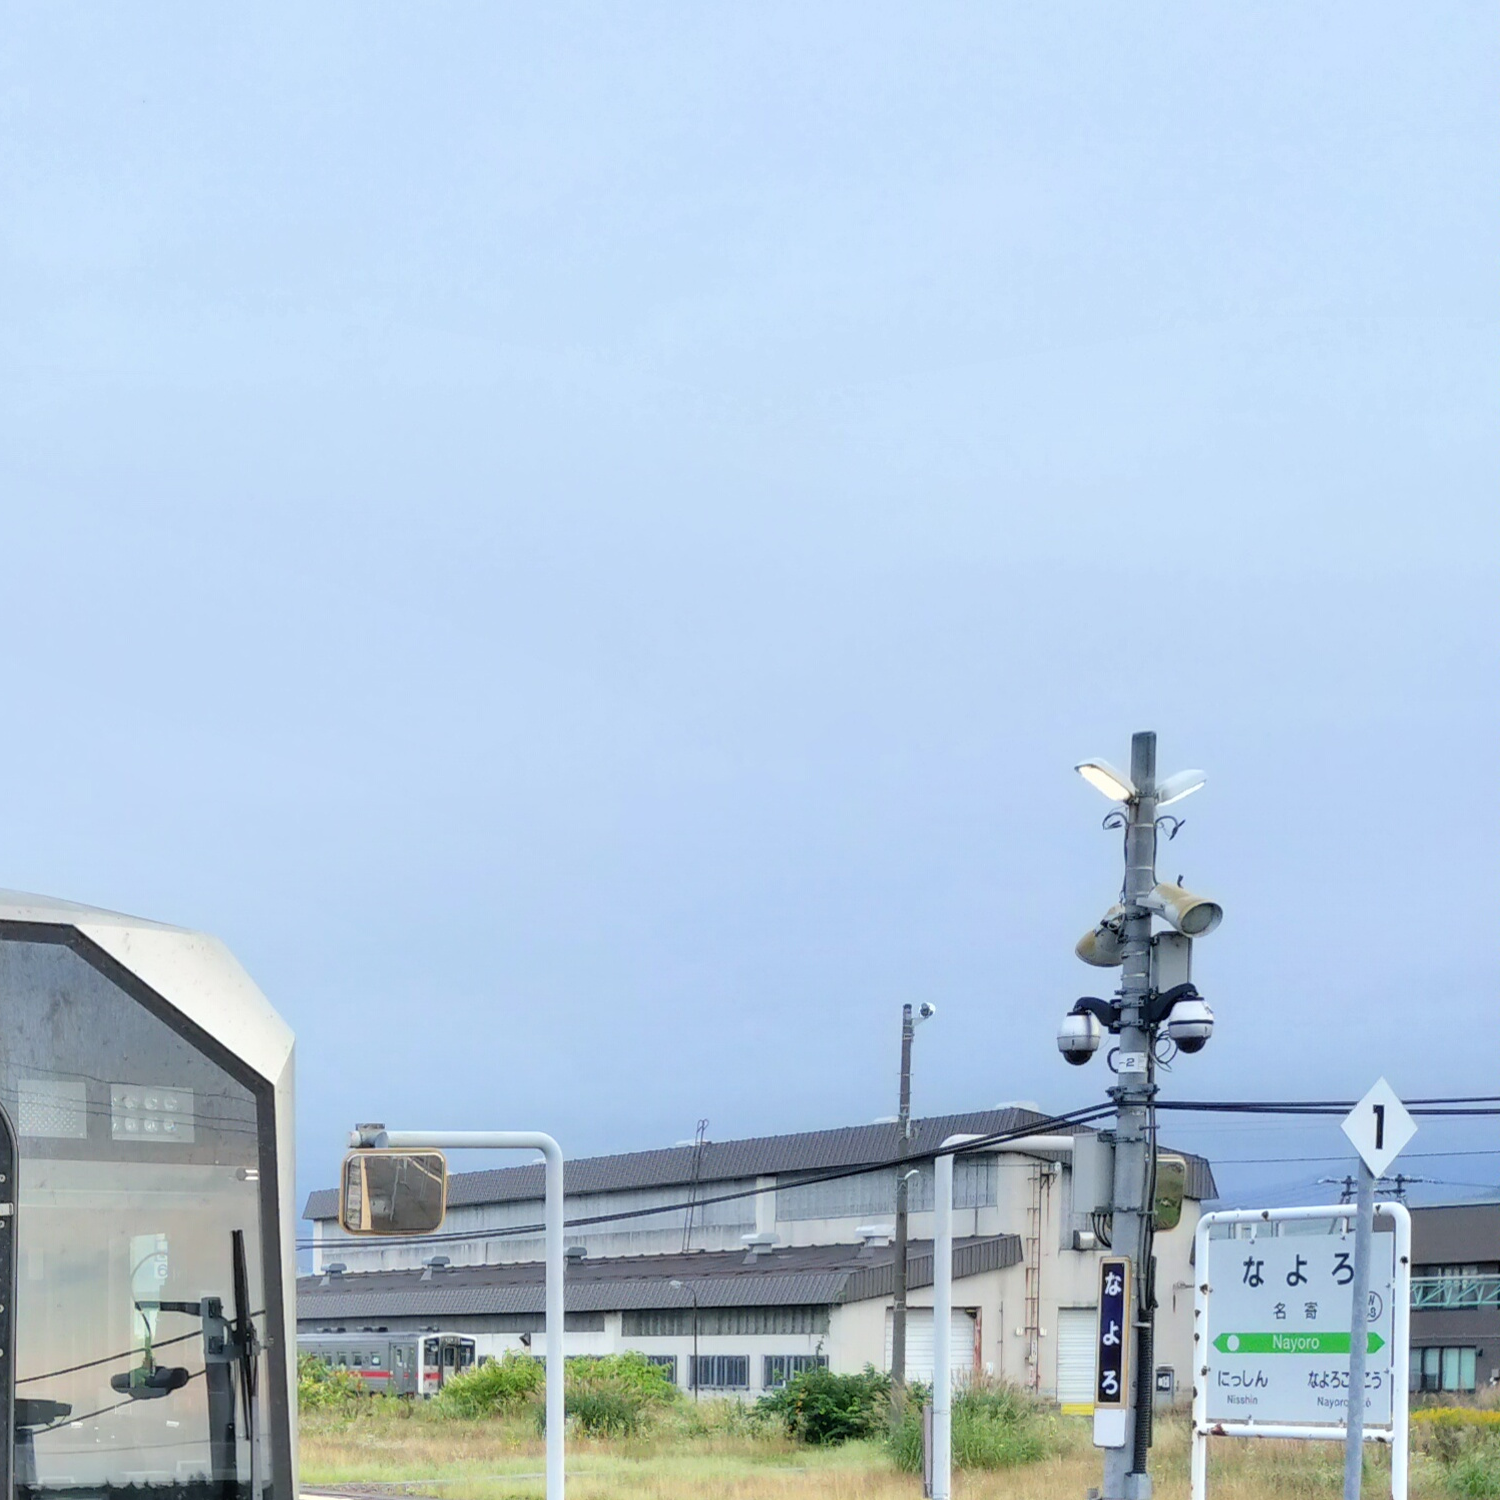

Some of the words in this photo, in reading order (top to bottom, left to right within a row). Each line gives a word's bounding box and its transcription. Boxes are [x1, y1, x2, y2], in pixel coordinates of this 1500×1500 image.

[1372, 1104, 1385, 1150] 1
[1243, 1252, 1355, 1288] なよろ
[1273, 1301, 1318, 1320] 名寄
[1102, 1271, 1122, 1396] なよろ
[1272, 1334, 1320, 1352] Nayoro
[1217, 1369, 1269, 1388] にっしん
[1226, 1394, 1259, 1405] Nisshin
